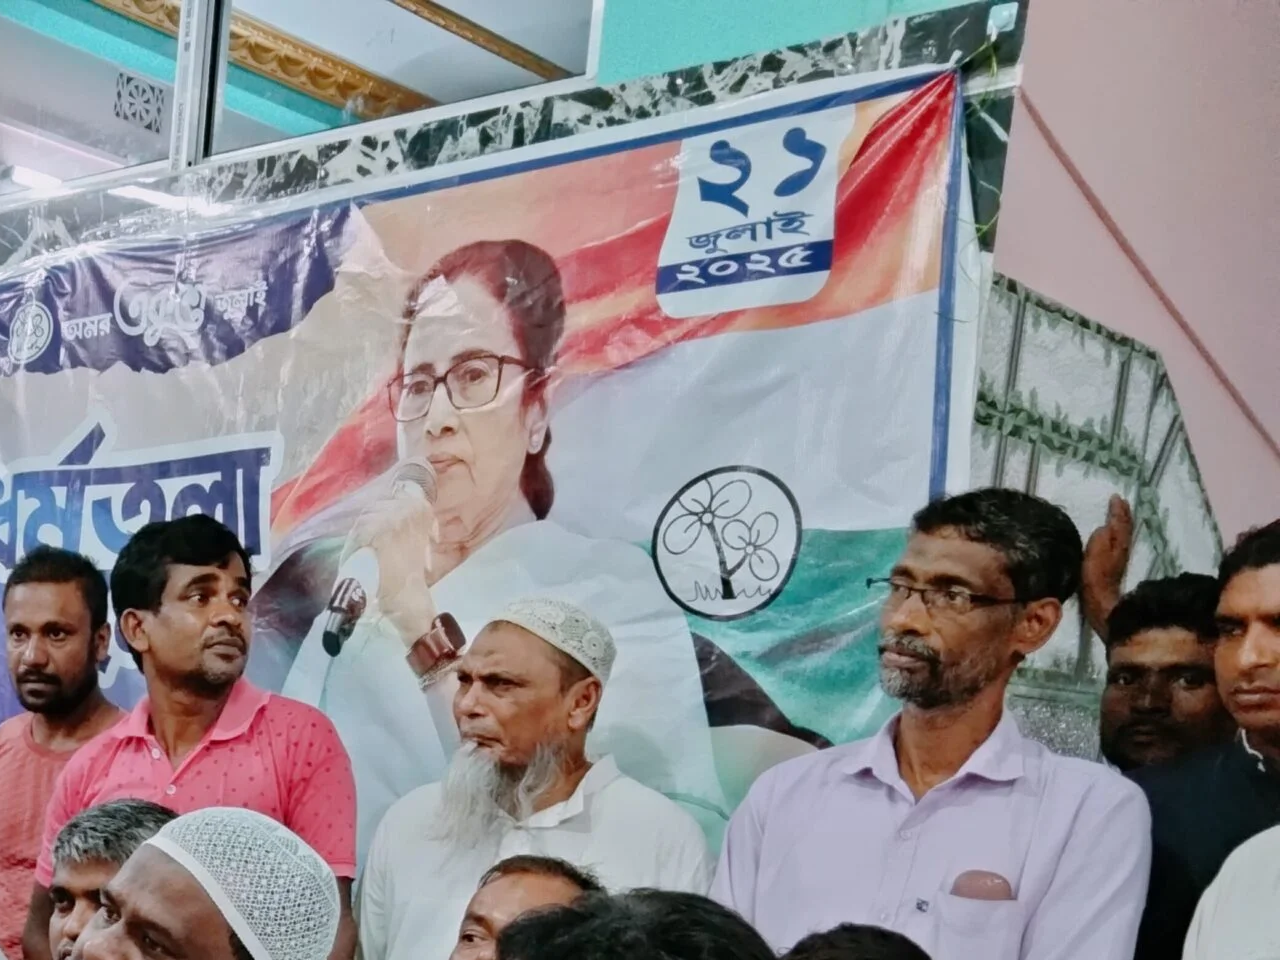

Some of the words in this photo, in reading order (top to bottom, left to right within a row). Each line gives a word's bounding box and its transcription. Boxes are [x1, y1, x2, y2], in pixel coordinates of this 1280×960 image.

[697, 127, 827, 218] ২১
[686, 211, 814, 255] জুলাই
[676, 247, 813, 285] ২০২৫
[61, 311, 113, 341] অমর
